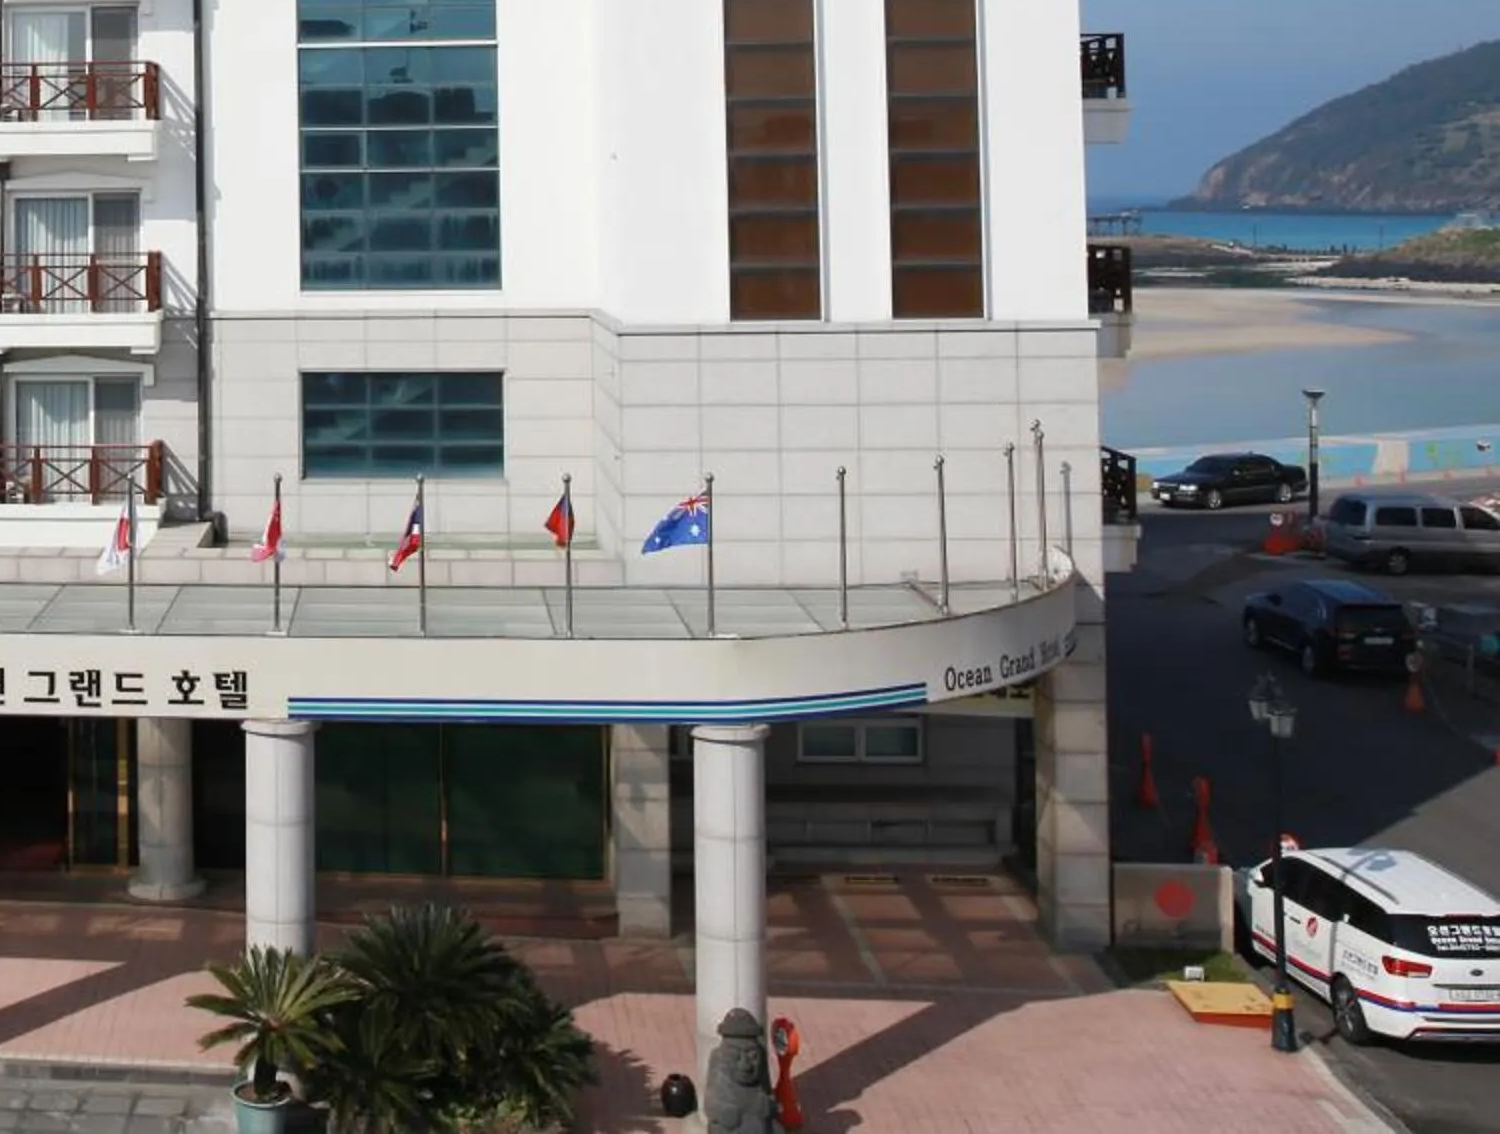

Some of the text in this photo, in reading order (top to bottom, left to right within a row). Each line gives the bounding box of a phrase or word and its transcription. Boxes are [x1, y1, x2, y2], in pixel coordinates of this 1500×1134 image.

[23, 669, 148, 708] 그랜드
[167, 669, 248, 710] 호텔
[944, 665, 993, 692] Ocean
[999, 645, 1036, 680] Grand
